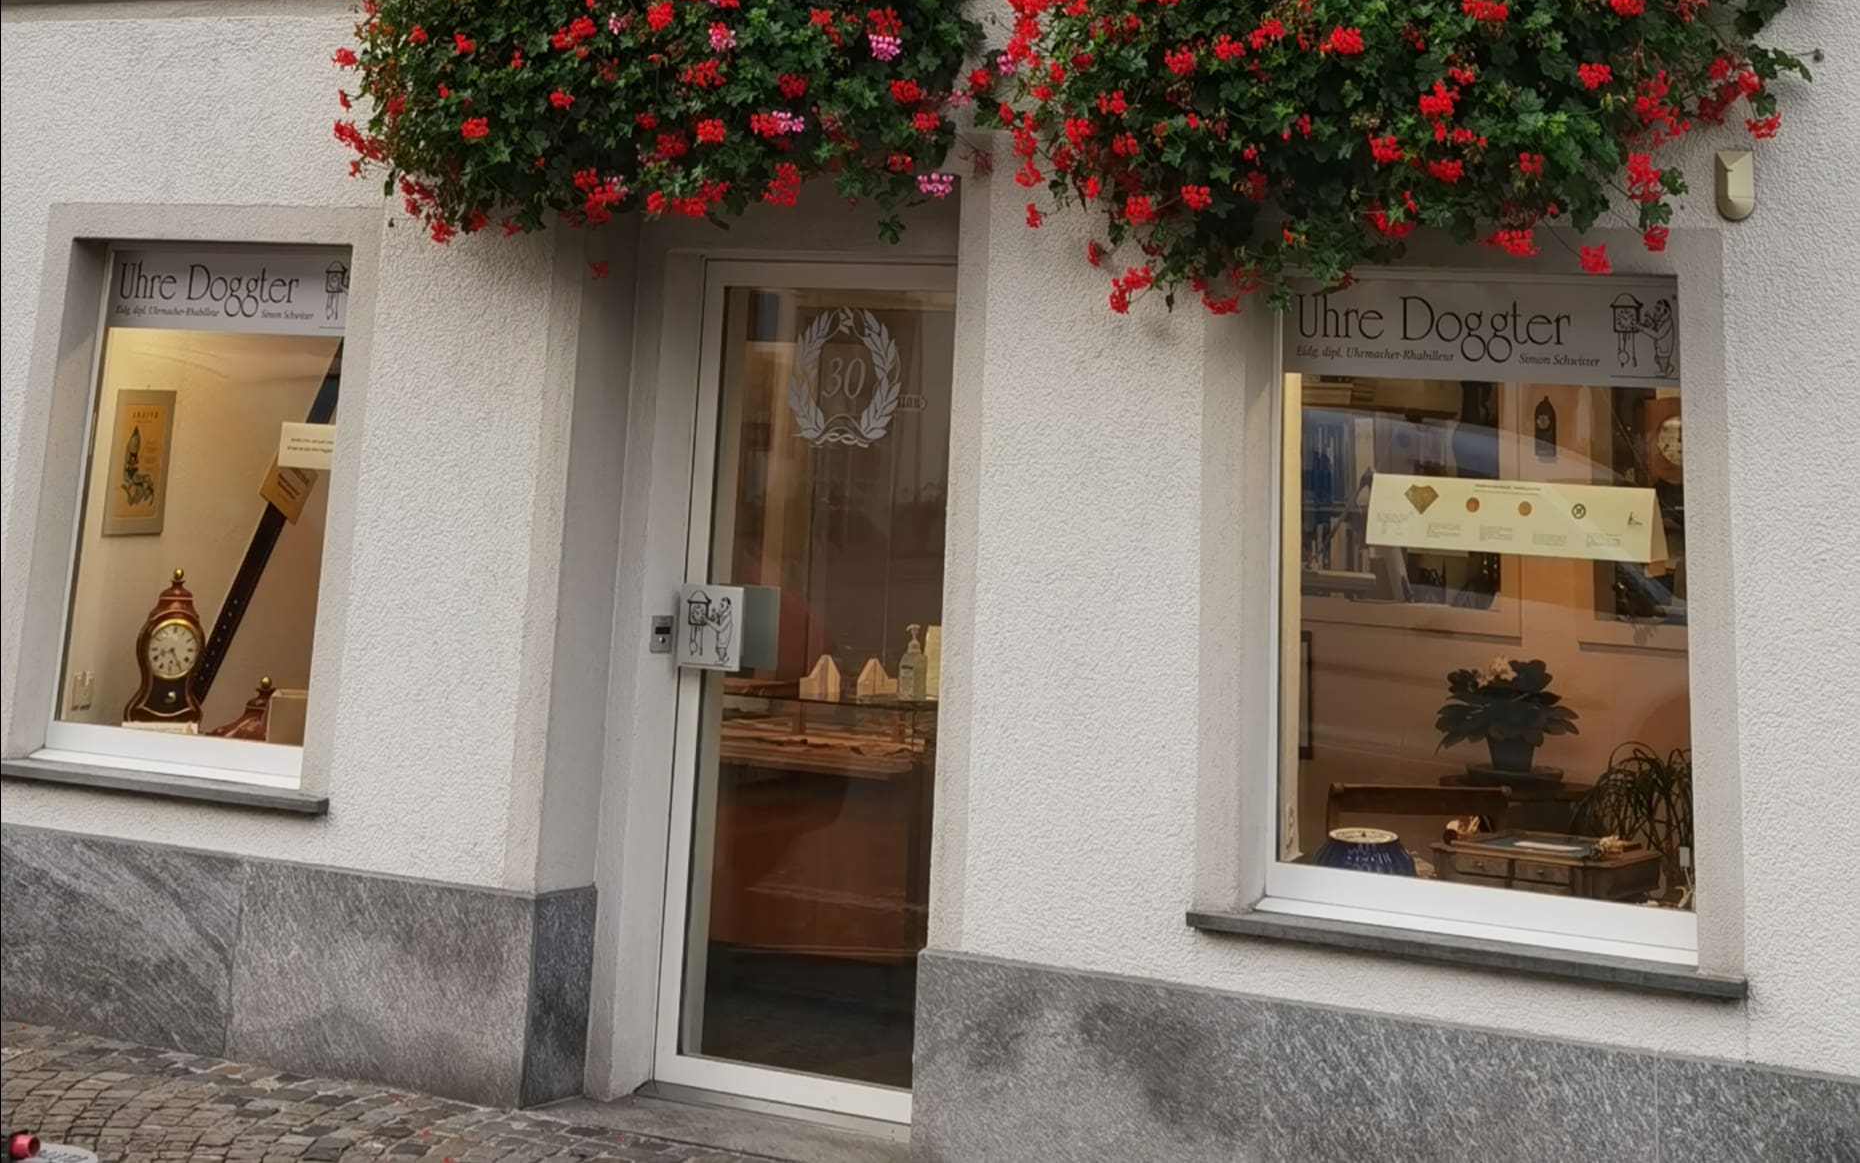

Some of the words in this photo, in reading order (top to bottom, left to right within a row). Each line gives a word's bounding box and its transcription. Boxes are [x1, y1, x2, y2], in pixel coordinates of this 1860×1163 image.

[119, 260, 177, 301] Uhre
[186, 263, 300, 318] Doggter
[1296, 292, 1385, 340] Uhre
[1400, 295, 1572, 363] Doggter
[821, 356, 867, 399] 30
[1518, 353, 1551, 365] Simon
